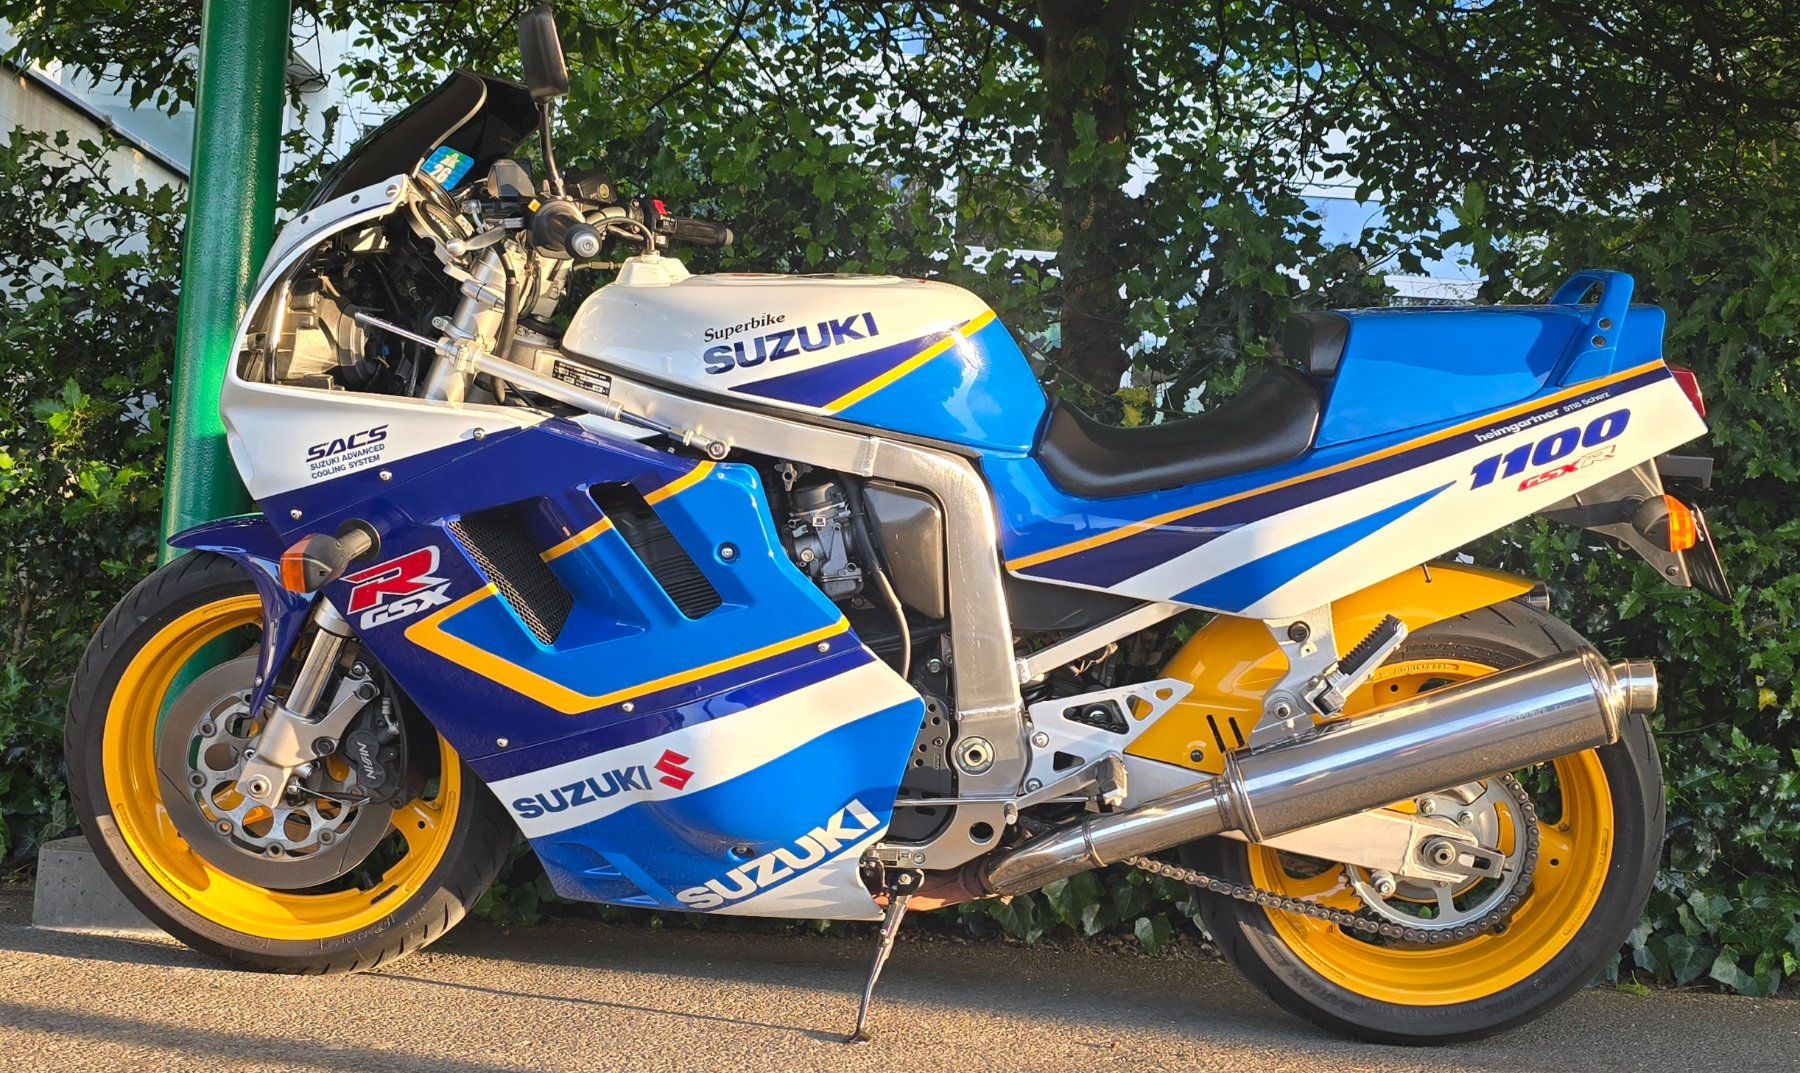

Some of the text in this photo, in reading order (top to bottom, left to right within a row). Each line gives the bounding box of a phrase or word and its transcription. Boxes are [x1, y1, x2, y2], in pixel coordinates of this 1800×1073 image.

[703, 311, 879, 375] SUZUKI
[704, 314, 786, 342] Superbike
[306, 424, 389, 462] SACS
[1470, 408, 1631, 490] 1100
[1474, 408, 1559, 443] heimgartner
[310, 443, 385, 471] SUZUKI ADVANCED
[311, 453, 381, 479] COOLING SYSTEM
[339, 545, 451, 615] R
[360, 582, 452, 630] GSX
[512, 765, 653, 819] SUZUKI
[676, 799, 880, 909] SUZUKI
